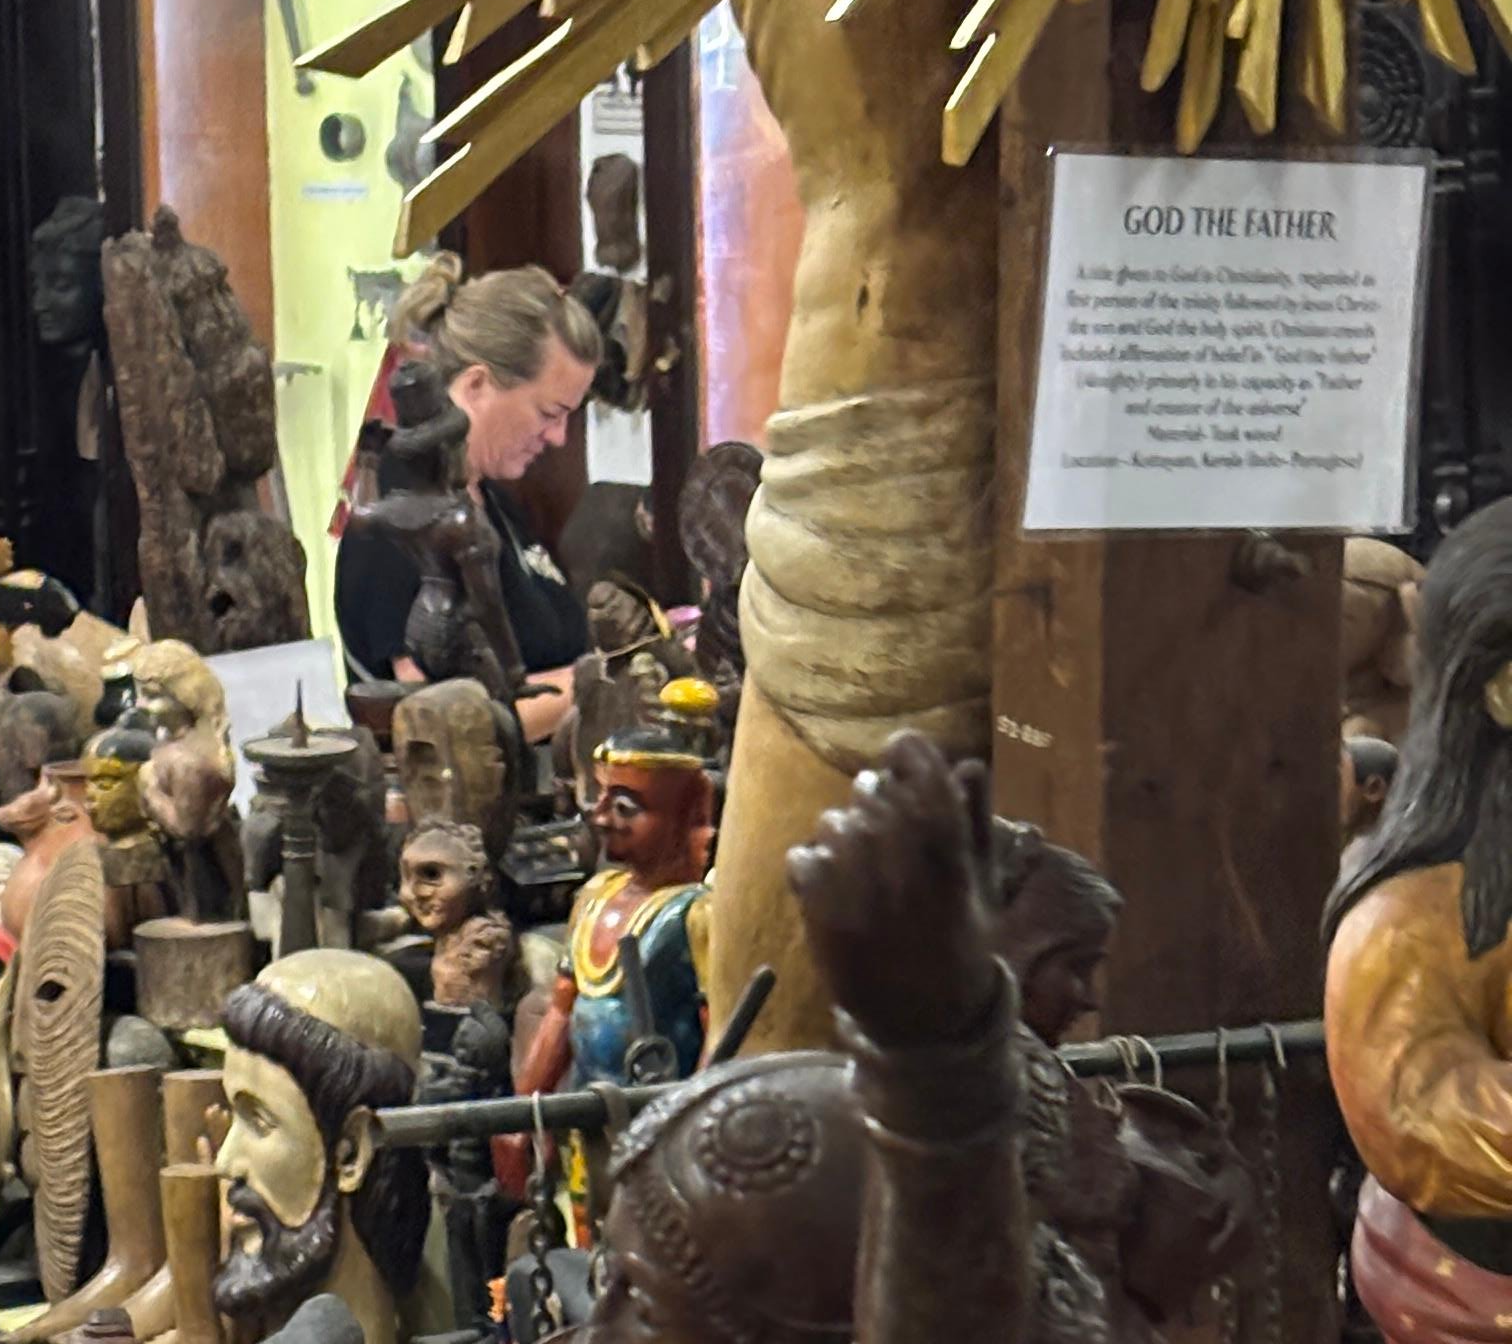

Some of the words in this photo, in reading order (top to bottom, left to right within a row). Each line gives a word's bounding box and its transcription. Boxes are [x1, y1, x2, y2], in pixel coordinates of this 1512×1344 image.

[1124, 206, 1184, 236] GOD
[1191, 207, 1236, 237] THE
[1245, 209, 1336, 240] FATHER
